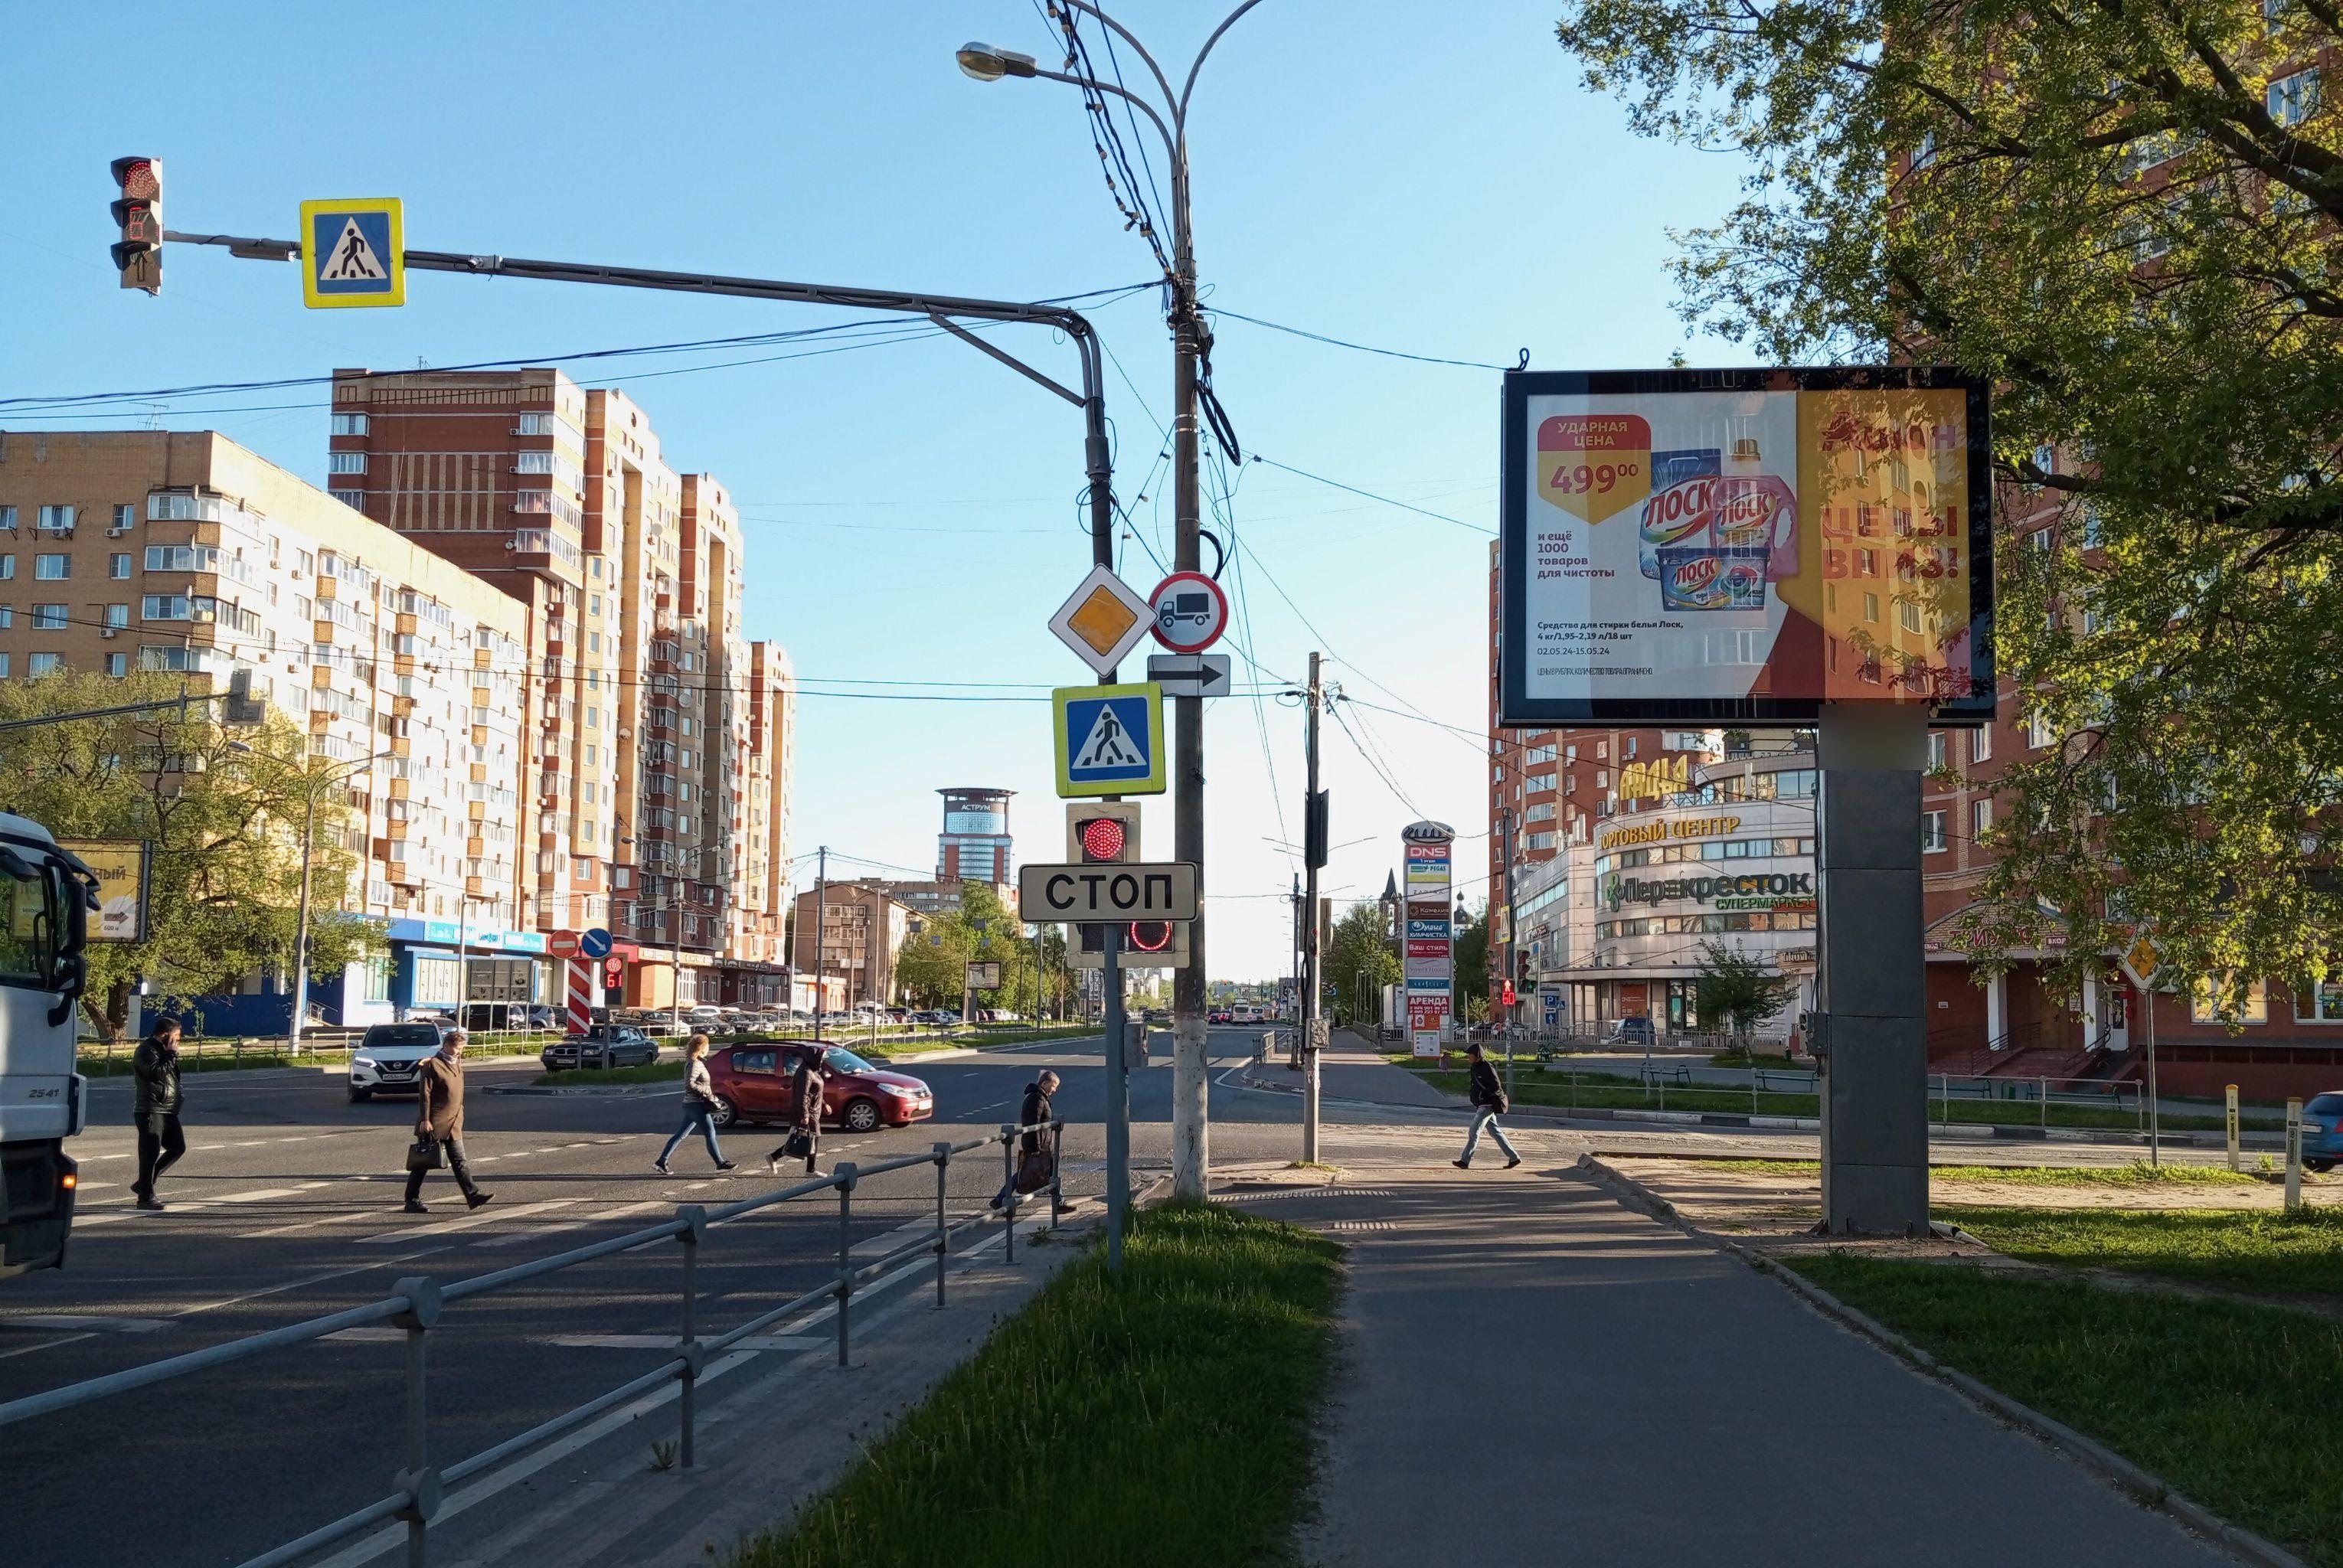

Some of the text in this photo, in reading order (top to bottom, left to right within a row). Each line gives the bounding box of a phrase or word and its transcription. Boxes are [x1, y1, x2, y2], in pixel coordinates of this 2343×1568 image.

[1557, 422, 1628, 434] УДАРНАЯ
[1574, 435, 1615, 448] ЦЕНА
[1645, 478, 1718, 528] ЛОСК
[1720, 493, 1770, 526] ЛОСК
[1547, 531, 1573, 542] ещё
[1537, 543, 1569, 553] 1000
[1537, 557, 1589, 567] товаров
[1537, 570, 1561, 580] для
[1675, 559, 1716, 584] ЛОСК
[1537, 622, 1579, 631] Средства
[1658, 620, 1684, 629] Лоск,
[1597, 632, 1619, 640] л/18
[1537, 647, 1610, 655] 02.05.24-15.05.24
[1600, 816, 1740, 849] ТОРГОВЫЙ ЦЕНТР
[1410, 847, 1446, 857] DNS
[1045, 874, 1172, 910] СТОП
[1716, 896, 1814, 910] СУПЕРМАРКЕТ
[607, 974, 622, 988] 61
[1410, 997, 1447, 1006] АРЕНДА
[1502, 992, 1515, 1004] 60
